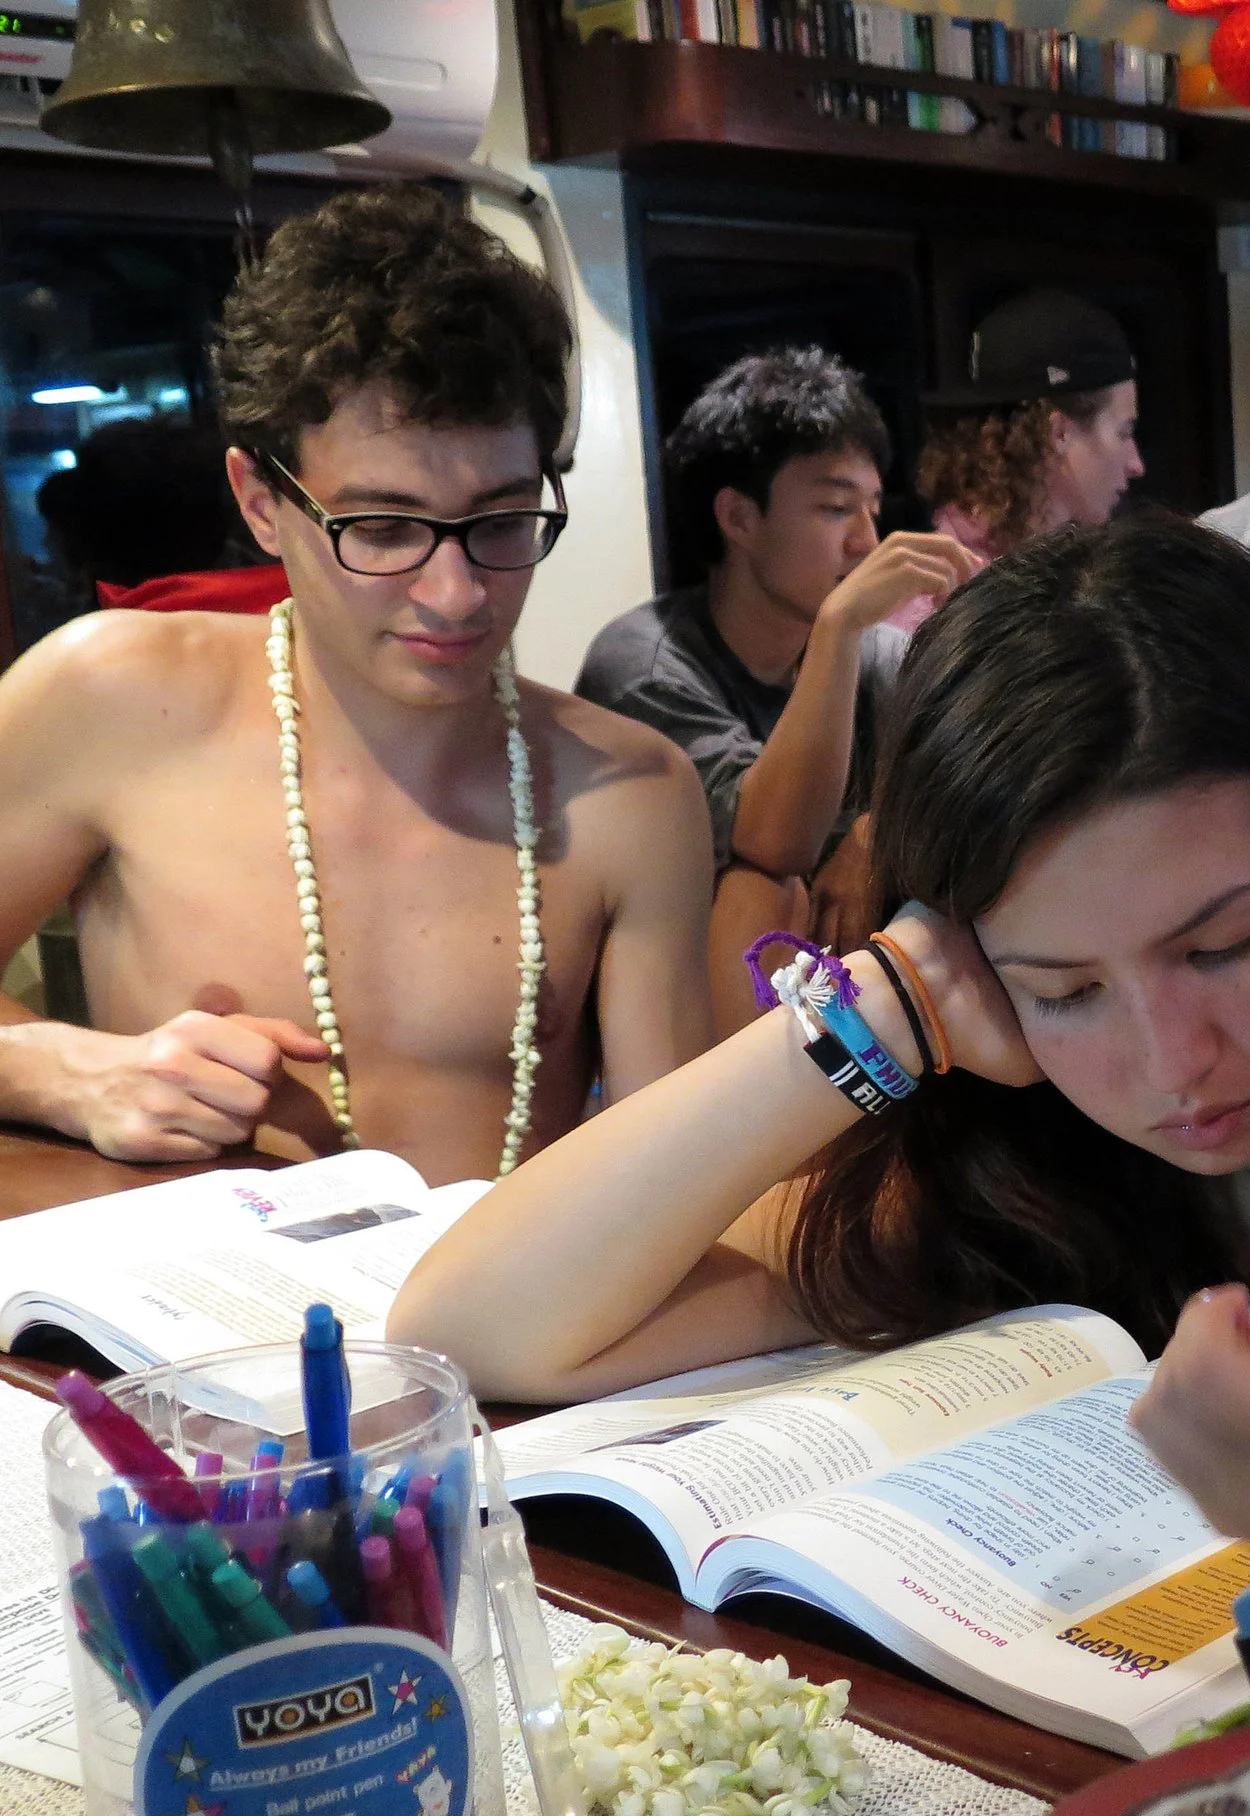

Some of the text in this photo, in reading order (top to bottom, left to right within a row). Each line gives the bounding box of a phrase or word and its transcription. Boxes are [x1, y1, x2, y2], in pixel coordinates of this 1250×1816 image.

[822, 1454, 845, 1480] weight
[682, 1484, 724, 1529] Estimating
[916, 1532, 952, 1559] following
[944, 1517, 1017, 1567] Buoyancy Check
[964, 1567, 994, 1588] Answer
[896, 1574, 1008, 1648] BUOYANCY CHECK
[993, 1608, 1033, 1633] buoyancy
[1055, 1626, 1170, 1674] CONCEPTS
[210, 1717, 418, 1787] Always my Friends!
[305, 1786, 348, 1812] point
[354, 1774, 384, 1798] pen
